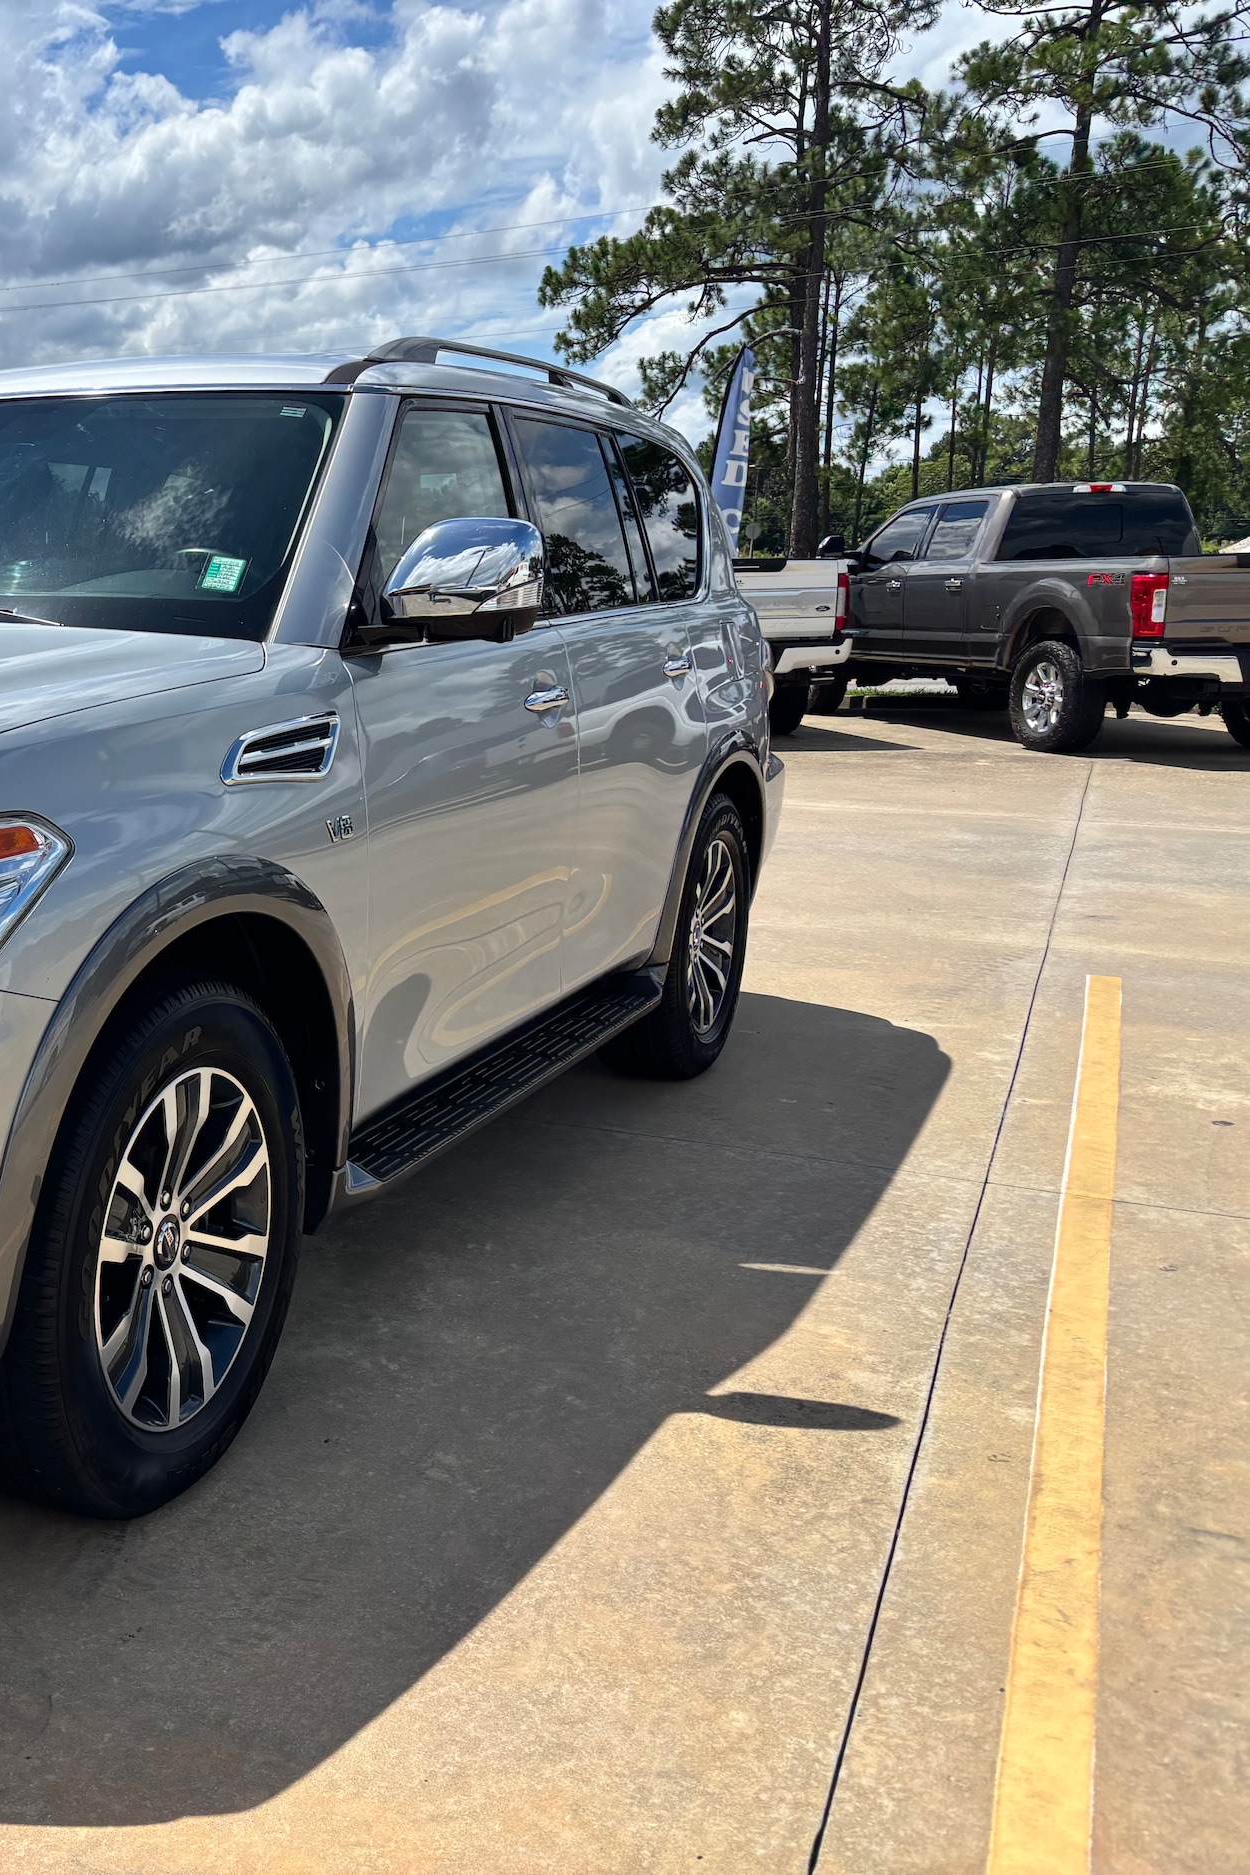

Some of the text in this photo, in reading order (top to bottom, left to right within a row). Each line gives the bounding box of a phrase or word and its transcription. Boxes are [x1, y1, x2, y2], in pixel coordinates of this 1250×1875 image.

[1087, 573, 1126, 586] FX4
[325, 814, 354, 843] V8
[78, 1025, 202, 1344] GOODYEAR
